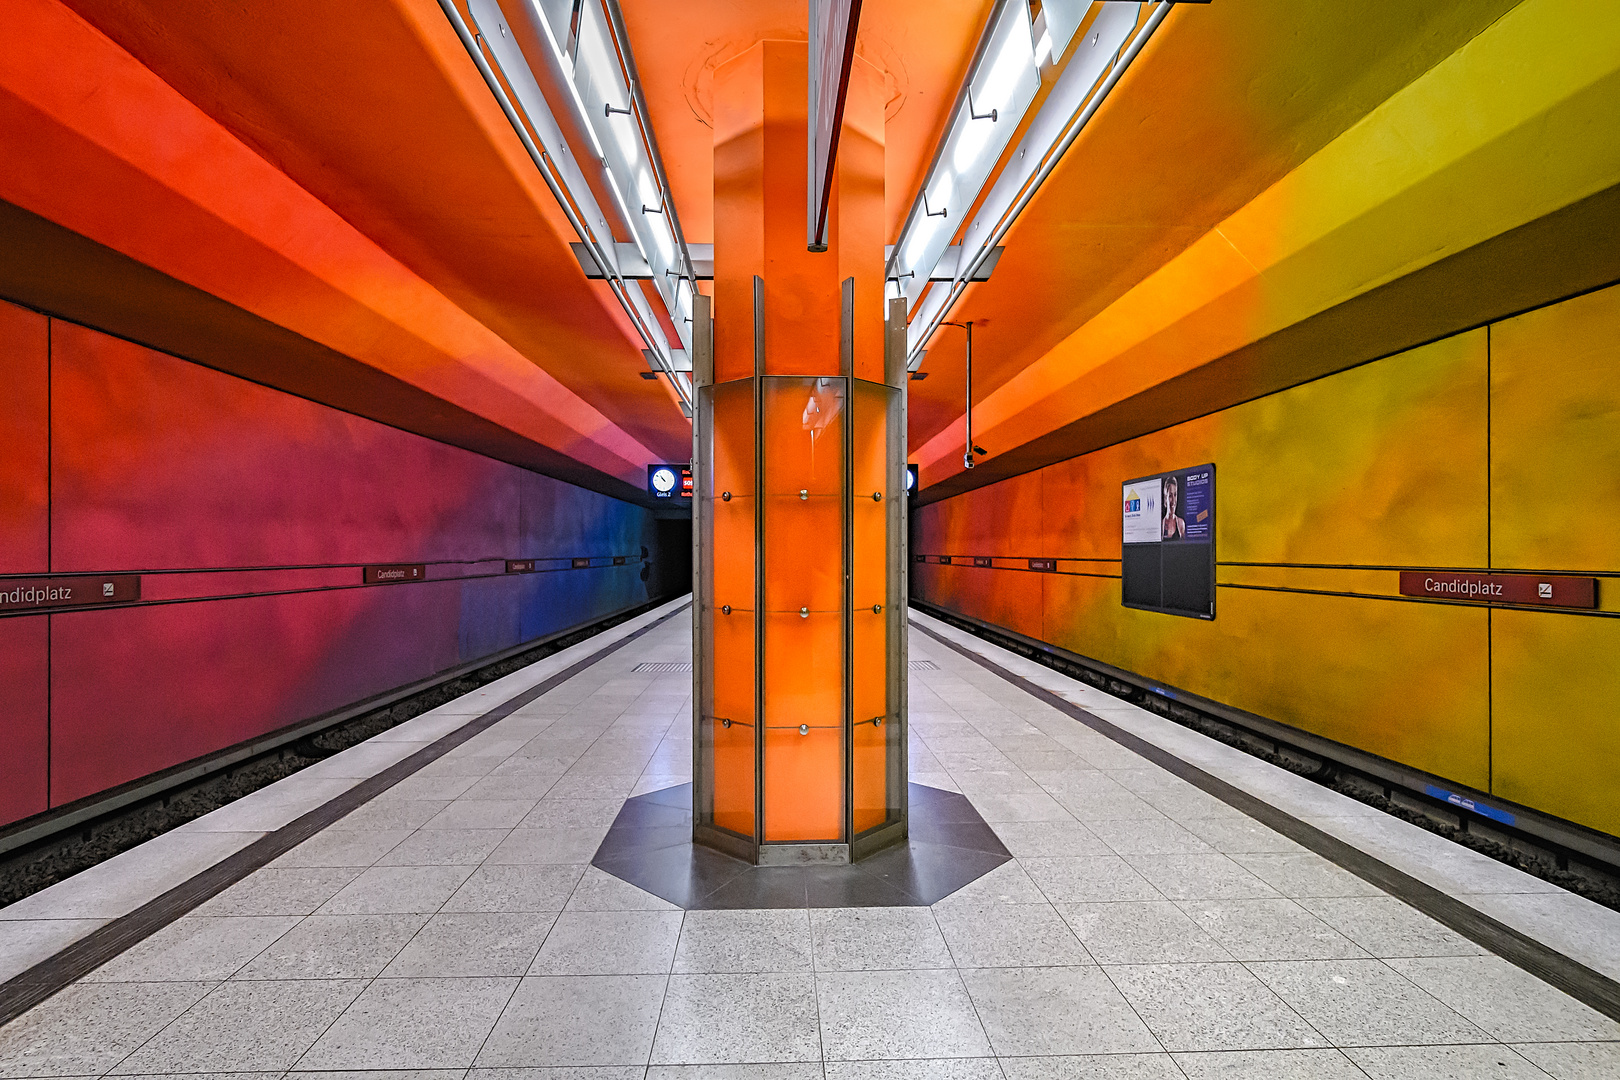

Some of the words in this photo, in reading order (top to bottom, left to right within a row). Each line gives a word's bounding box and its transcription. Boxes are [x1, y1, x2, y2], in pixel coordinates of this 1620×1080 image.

[377, 569, 405, 579] Candidplatz
[0, 586, 72, 605] ndidplatz
[1424, 578, 1503, 597] Candidplatz
